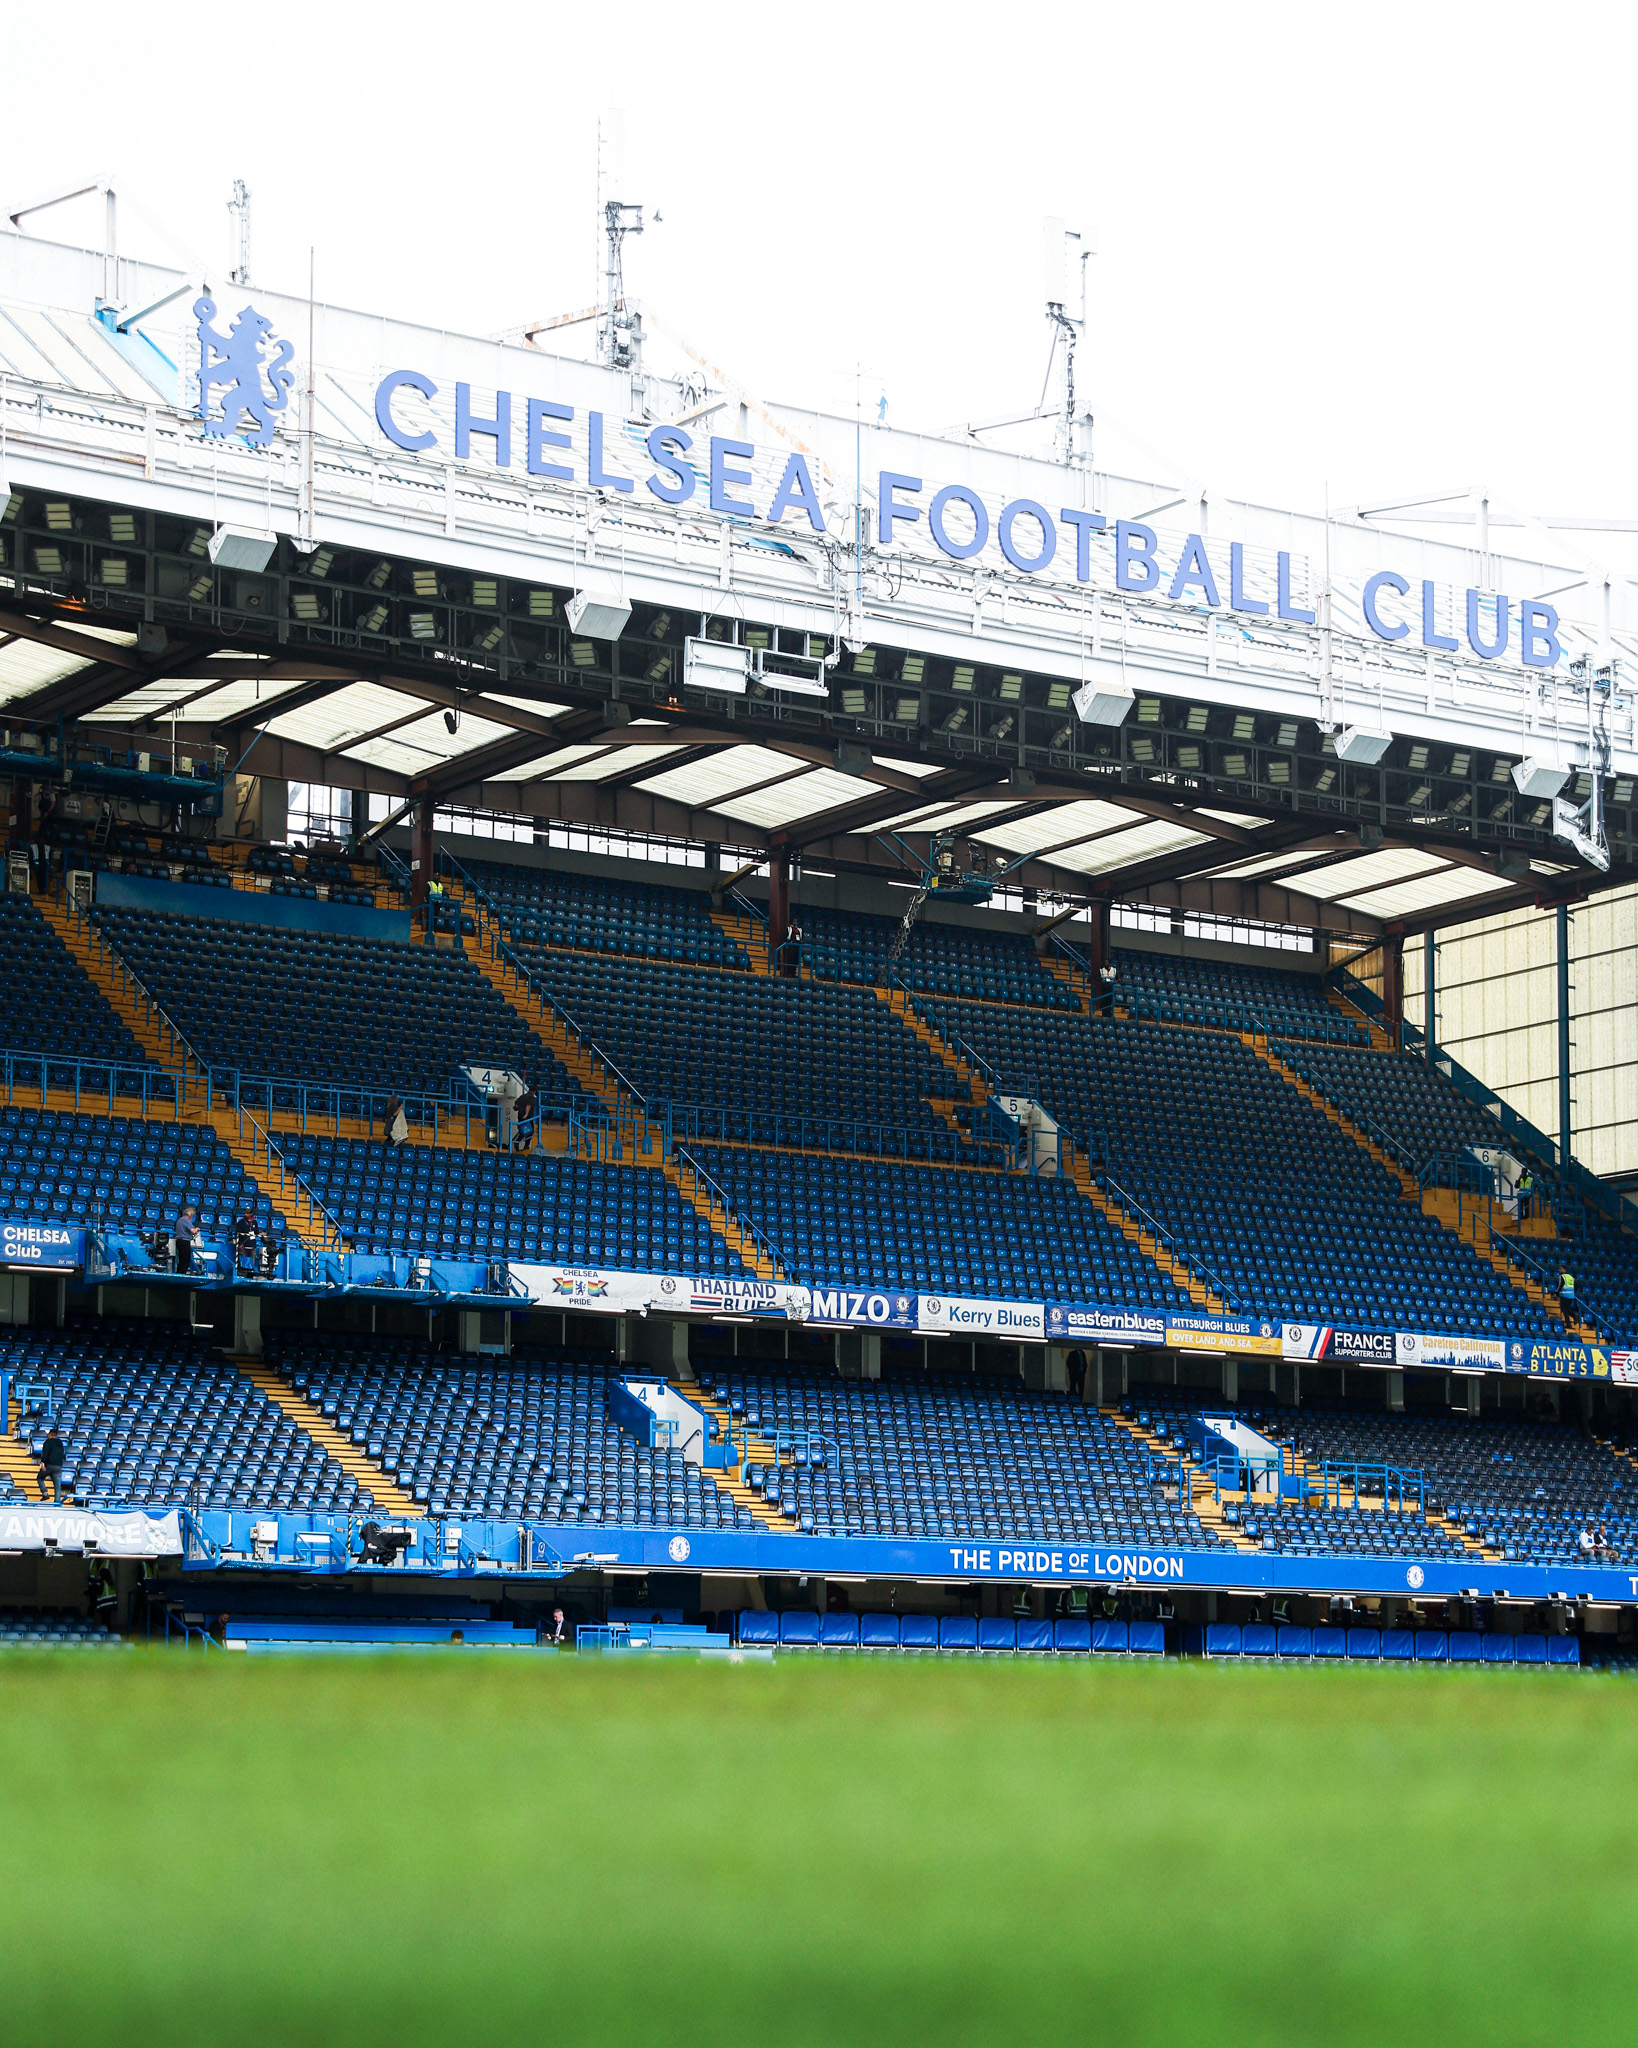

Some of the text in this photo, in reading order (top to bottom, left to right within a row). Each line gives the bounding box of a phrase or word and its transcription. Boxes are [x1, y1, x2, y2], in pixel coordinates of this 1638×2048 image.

[374, 370, 1562, 667] CHELSEA FOOTBALL CLUB
[482, 1071, 491, 1084] 4
[1010, 1099, 1017, 1112] 5
[1482, 1151, 1489, 1162] 6
[3, 1226, 71, 1244] CHELSEA
[4, 1242, 42, 1258] Club
[562, 1268, 598, 1278] CHELSEA
[689, 1278, 777, 1299] THAILAND
[569, 1298, 592, 1306] PRIDE
[812, 1290, 890, 1322] MIZO
[949, 1305, 992, 1327] Kerry
[997, 1309, 1040, 1328] Blues
[1067, 1310, 1164, 1331] easternblues
[1172, 1317, 1250, 1333] PITTSBURGH BLUES
[1172, 1333, 1194, 1343] OVER
[1195, 1334, 1216, 1345] LAND
[1218, 1336, 1236, 1347] AND
[1237, 1338, 1252, 1348] SEA
[1334, 1332, 1392, 1351] FRANCE
[1422, 1336, 1501, 1353] Carefree California
[1334, 1348, 1375, 1358] SUPPORTERS
[1375, 1350, 1392, 1359] CLUB
[1531, 1345, 1587, 1362] ATLANTA
[637, 1387, 647, 1402] 4
[1213, 1423, 1221, 1436] 5
[4, 1515, 142, 1545] ANYMORE
[949, 1548, 1184, 1577] THE PRIDE OF LONDON
